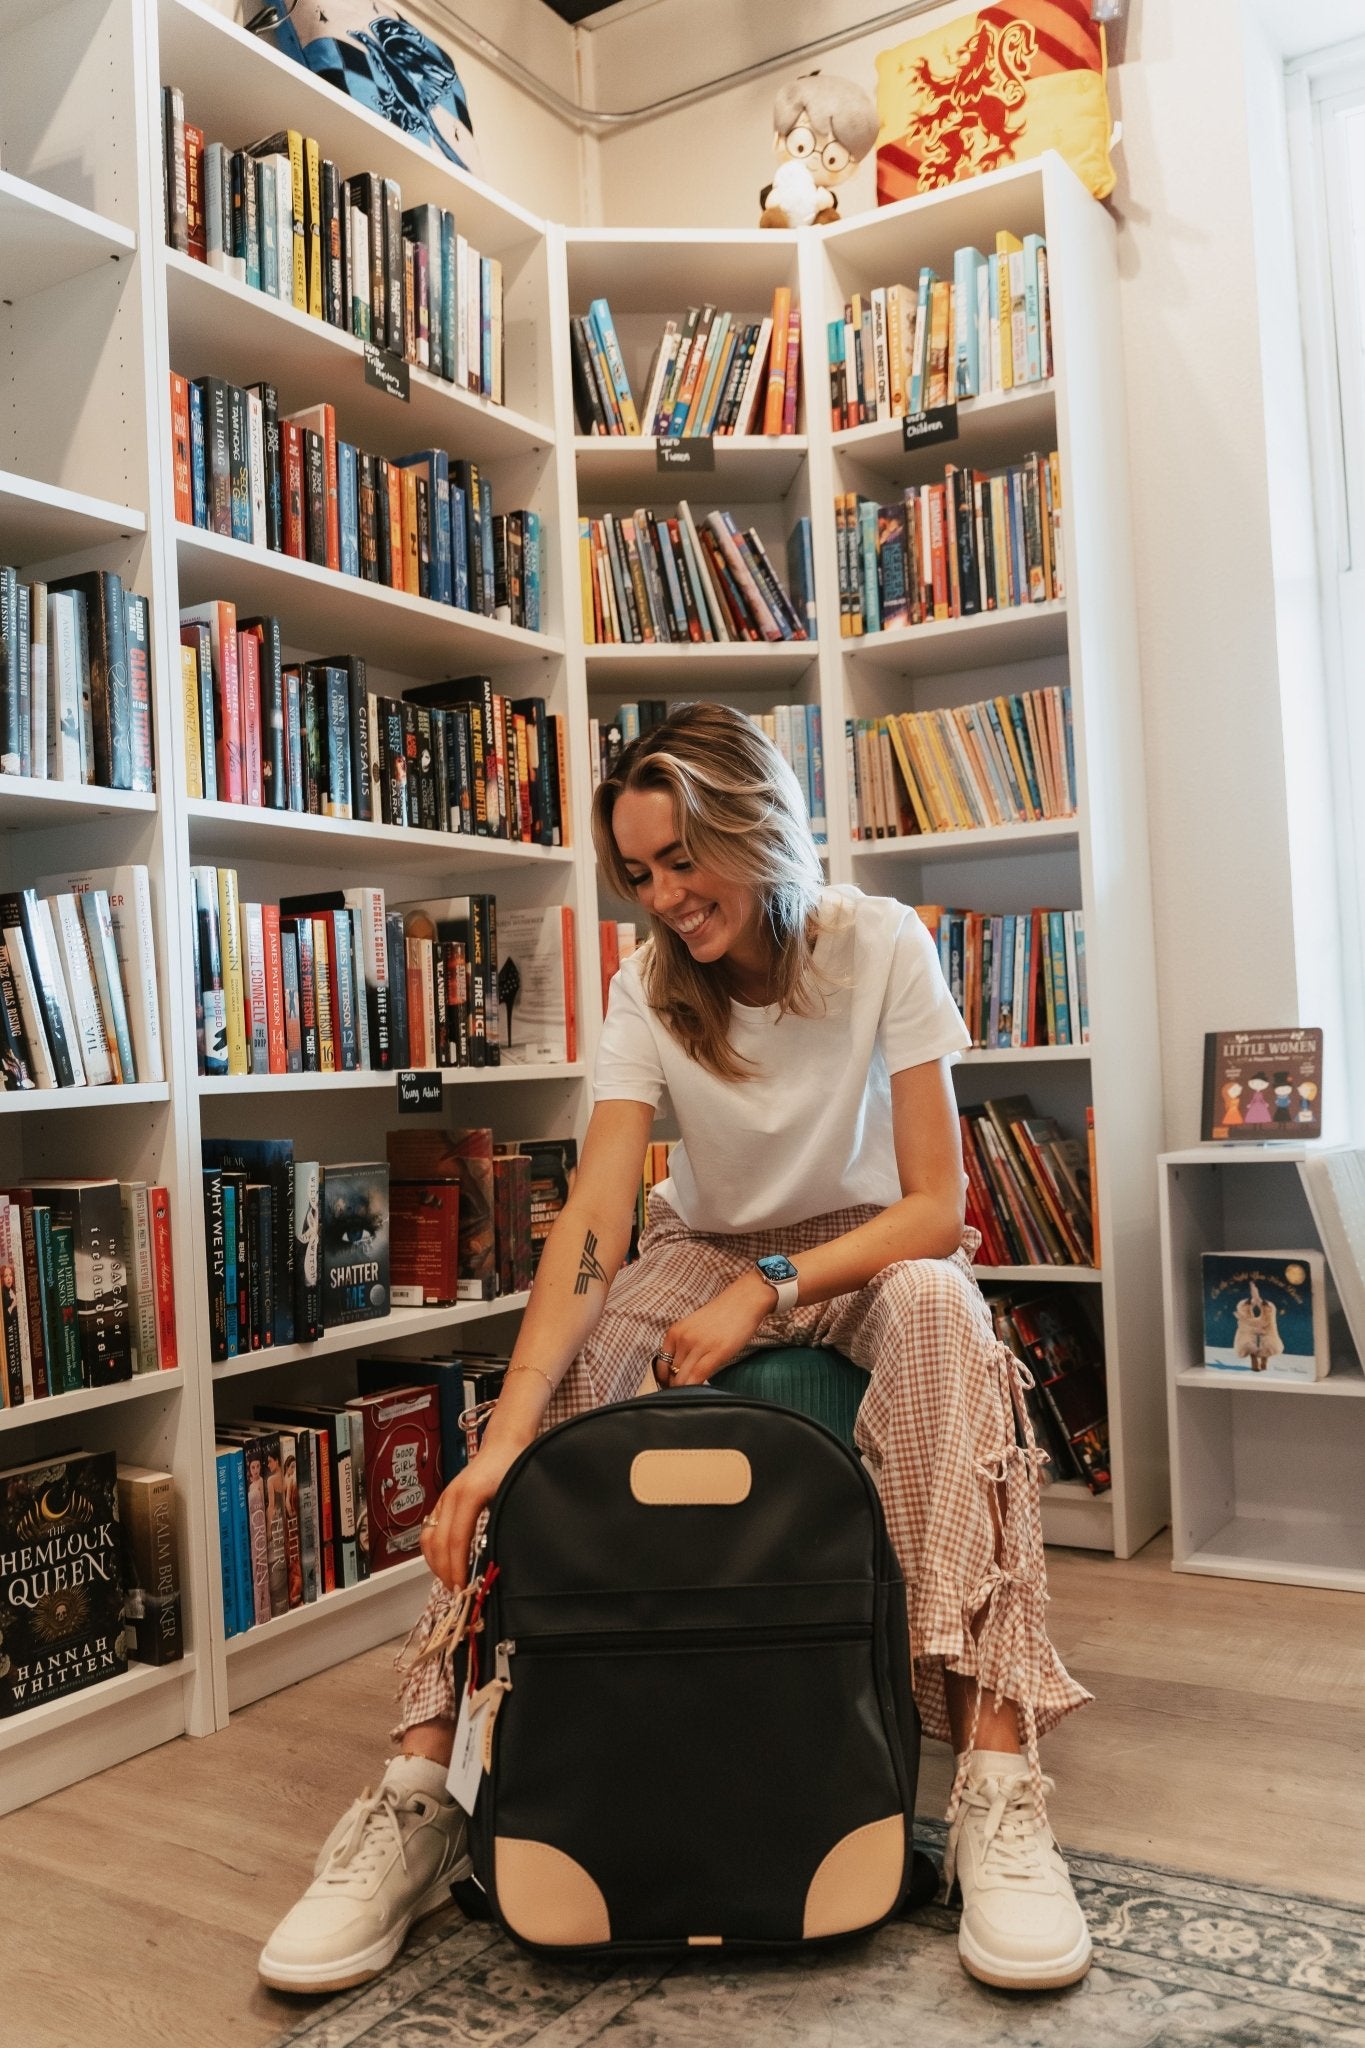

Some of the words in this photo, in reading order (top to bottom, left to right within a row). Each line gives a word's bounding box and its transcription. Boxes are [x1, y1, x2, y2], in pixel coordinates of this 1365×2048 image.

[294, 188, 305, 217] CHILD
[330, 218, 341, 258] KILLING
[448, 236, 456, 282] PAULA
[331, 259, 342, 296] WOODS
[215, 389, 224, 424] TAMI
[231, 405, 240, 428] TAMI
[233, 429, 241, 462] HOAG
[250, 415, 258, 454] TAMI
[267, 421, 275, 452] HOAG
[328, 425, 336, 453] TAMI
[906, 420, 944, 438] Children
[217, 429, 226, 466] HOAG
[252, 454, 260, 496] HOAG
[232, 487, 240, 526] GRAVE
[240, 466, 249, 527] SECRETS
[0, 570, 8, 593] THE
[1, 596, 9, 641] MISSING
[19, 589, 27, 619] BATTLE
[134, 600, 144, 642] RICHARD
[19, 631, 28, 672] AMERICAN
[61, 618, 71, 669] AMERICAN
[229, 627, 237, 662] SHAY
[247, 639, 256, 668] Liane
[273, 625, 281, 679] GETTING
[20, 674, 28, 696] MIND
[131, 648, 147, 700] CLASH
[247, 667, 257, 713] Moriarty
[483, 680, 492, 701] IAN
[186, 687, 197, 732] KOONTZ
[230, 664, 239, 723] MITCHELL
[274, 680, 282, 707] LIFE
[331, 689, 339, 726] O'BRIEN
[337, 694, 345, 723] KEVIN
[493, 700, 502, 718] IAN
[472, 708, 482, 731] NICK
[485, 702, 494, 745] RANKIN
[132, 711, 150, 768] TITANS
[206, 708, 215, 776] VANISHING
[358, 707, 370, 796] CHRYSALIS
[473, 732, 484, 763] PETRIE
[494, 719, 504, 760] RANKIN
[188, 736, 198, 784] VELOCITY
[336, 736, 345, 798] UNSPEAKABLE
[391, 778, 399, 816] DARK
[421, 778, 429, 814] CLOSET
[475, 779, 487, 821] DRIFTER
[71, 883, 90, 894] THE
[373, 894, 383, 933] MICHAEL
[472, 903, 481, 926] J.A.
[268, 930, 279, 965] JAMES
[337, 931, 348, 964] JAMES
[375, 936, 386, 981] CRICHTON
[474, 928, 482, 965] JANCE
[316, 960, 329, 990] JAMES
[474, 976, 484, 1007] FIRE
[2, 980, 15, 1006] GIRLS
[212, 977, 223, 1028] ENTOMBED
[251, 969, 266, 1024] CONNELLY
[271, 966, 281, 1026] PATTERSON
[301, 974, 315, 1027] PATTERSON
[341, 966, 352, 1028] PATTERSON
[377, 986, 388, 1014] STATE
[7, 1008, 22, 1037] RISING
[319, 992, 333, 1042] PATTERSON
[475, 1014, 485, 1037] ICE
[255, 1038, 267, 1049] DROP
[271, 1030, 284, 1045] 14
[305, 1035, 316, 1055] CHEF
[322, 1045, 334, 1063] 16
[342, 1031, 354, 1044] 12
[378, 1026, 389, 1049] FEAR
[1223, 1042, 1266, 1057] LITTLE
[1268, 1040, 1317, 1055] WOMEN
[401, 1084, 420, 1104] Young
[422, 1086, 441, 1098] Adult
[211, 1177, 222, 1217] WHY
[285, 1165, 295, 1197] BEAR
[136, 1192, 146, 1227] WHISTLING
[3, 1205, 13, 1265] UNBRIDLED
[43, 1212, 52, 1244] Ottessa
[213, 1221, 224, 1248] WE
[286, 1208, 295, 1273] NIGHTINGALE
[45, 1246, 54, 1287] Moshfegh
[139, 1250, 151, 1290] GRAVEYARD
[214, 1250, 225, 1279] FLY
[251, 1261, 259, 1276] SEA
[309, 1245, 317, 1280] WITCH
[330, 1262, 379, 1289] SHATTER
[56, 1268, 66, 1307] MASON
[64, 1266, 75, 1306] DEBBIE
[111, 1262, 123, 1318] SAGAS
[346, 1283, 366, 1308] ME
[252, 1286, 260, 1326] MONSTERS
[264, 1298, 272, 1325] CURSE
[63, 1325, 71, 1353] Harmony
[68, 1330, 76, 1358] Christmas
[114, 1324, 122, 1335] of
[7, 1325, 17, 1374] WHITSON
[236, 1460, 244, 1481] JOHN
[321, 1442, 330, 1465] JOHN
[394, 1460, 413, 1474] GIRL
[395, 1448, 415, 1459] GOOD
[219, 1465, 227, 1485] JOHN
[322, 1465, 331, 1505] GRISHAM
[343, 1462, 355, 1504] dream
[399, 1475, 417, 1487] BAD
[221, 1486, 229, 1513] GREEN
[238, 1483, 246, 1509] GREEN
[395, 1492, 422, 1510] BLOOD
[47, 1525, 66, 1539] THE
[153, 1501, 171, 1561] REALM
[344, 1507, 355, 1530] girl
[0, 1522, 115, 1577] HEMLOCK
[250, 1509, 268, 1586] CROWN
[271, 1517, 285, 1572] HEIR
[287, 1517, 301, 1563] ELITE
[8, 1551, 112, 1609] QUEEN
[157, 1564, 177, 1640] BREAKER
[12, 1651, 115, 1700] WHITTEN
[17, 1636, 108, 1683] HANNAH
